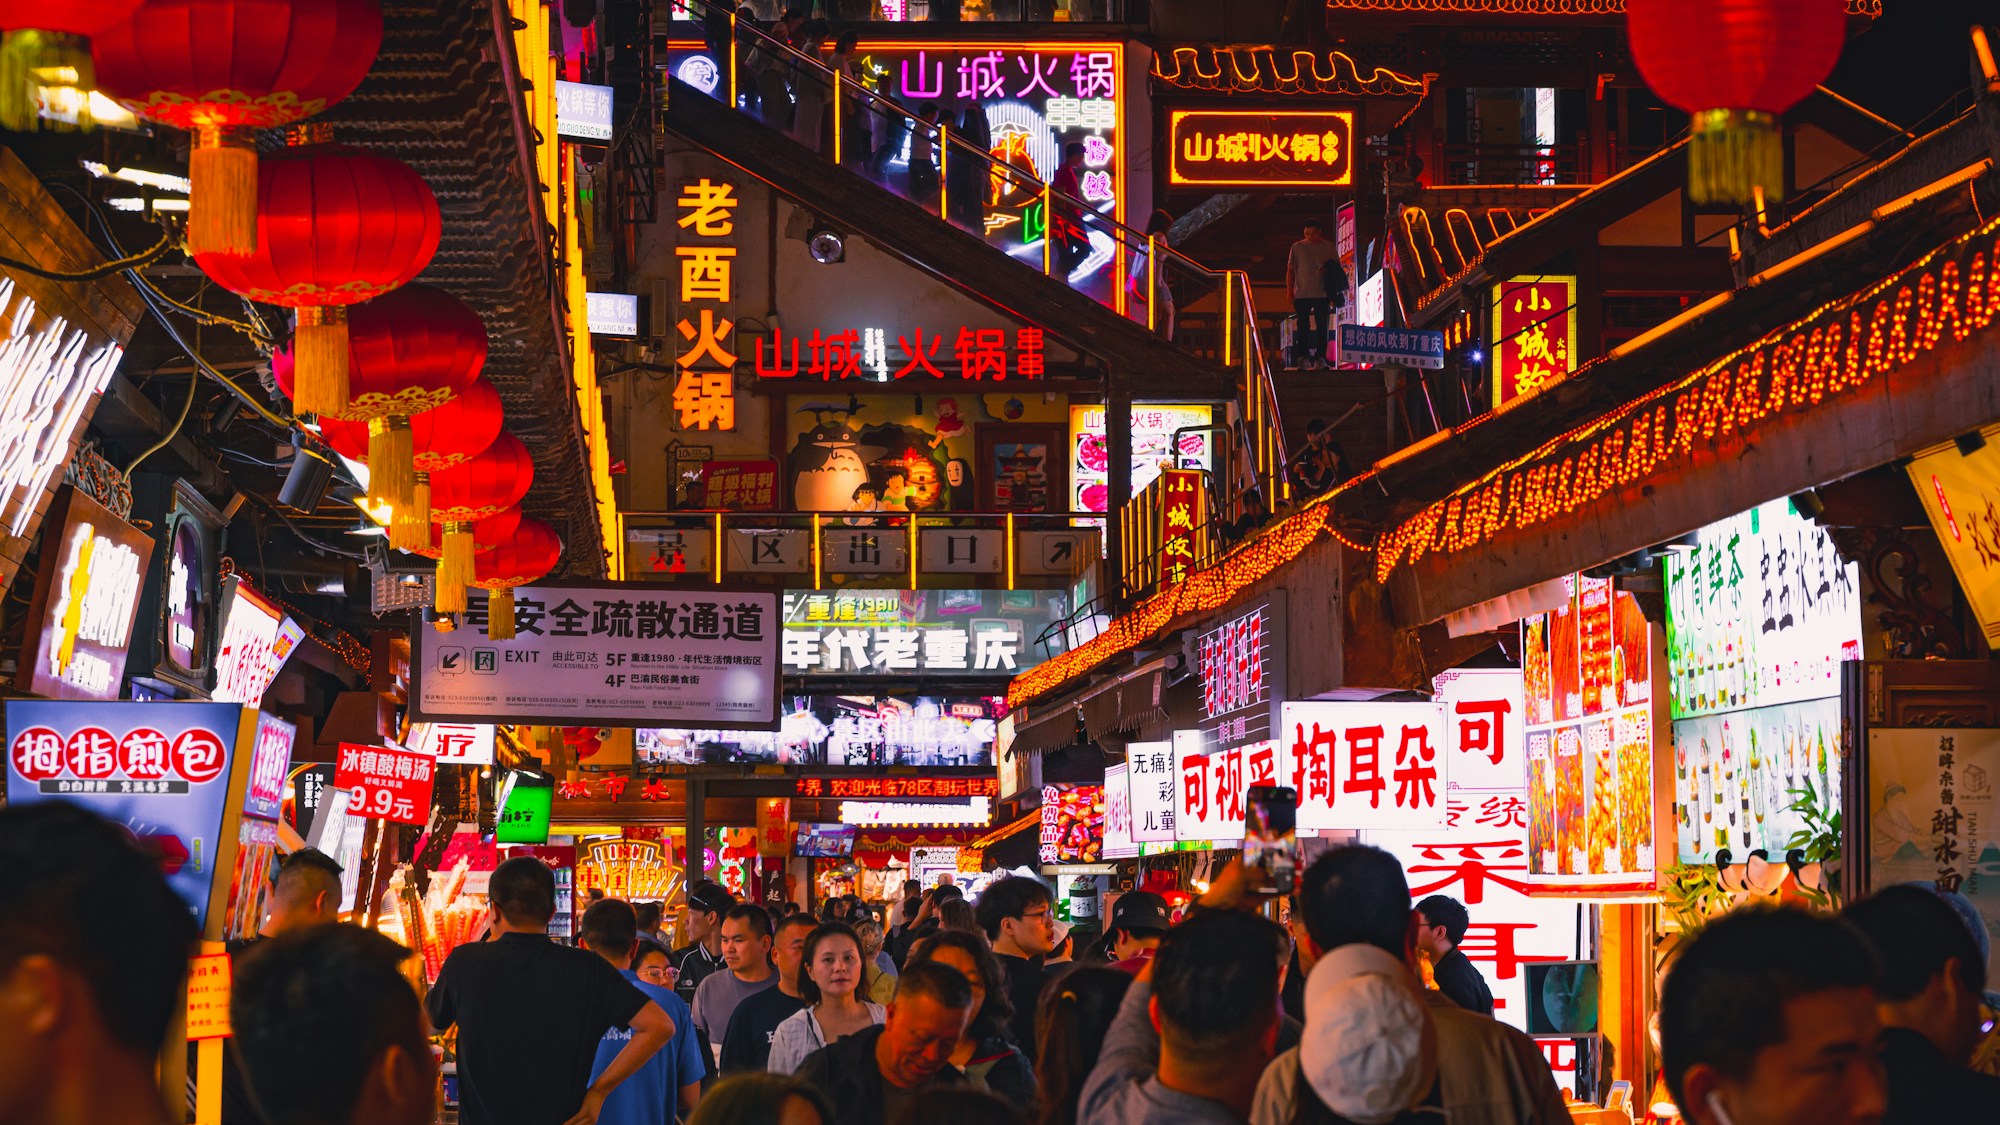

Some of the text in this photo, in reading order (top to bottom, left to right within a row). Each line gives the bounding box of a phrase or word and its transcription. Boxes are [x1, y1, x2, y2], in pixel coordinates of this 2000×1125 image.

[901, 51, 1115, 100] 山城火锅
[1047, 95, 1116, 135] 串串
[672, 179, 738, 431] 老酉火锅
[1345, 329, 1441, 353] 想你的风吹到了重庆
[505, 650, 540, 663] EXIT
[552, 650, 599, 663] 由此可达
[606, 653, 627, 667] 5F
[605, 674, 700, 687] 4F 巴渝民俗美食街
[1455, 698, 1512, 766] 可
[17, 732, 221, 777] 拇指煎包
[341, 749, 431, 782] 冰镇酸梅汤
[1134, 752, 1174, 775] 无痛
[1292, 721, 1437, 809] 掏耳朵
[349, 785, 415, 821] 9.9元
[831, 779, 999, 796] 欢迎光临78区潮玩世界
[1039, 786, 1060, 863] 免费品尝
[1931, 806, 1964, 895] 甜水面
[1968, 811, 1978, 895] TIAN SHUI MIAN
